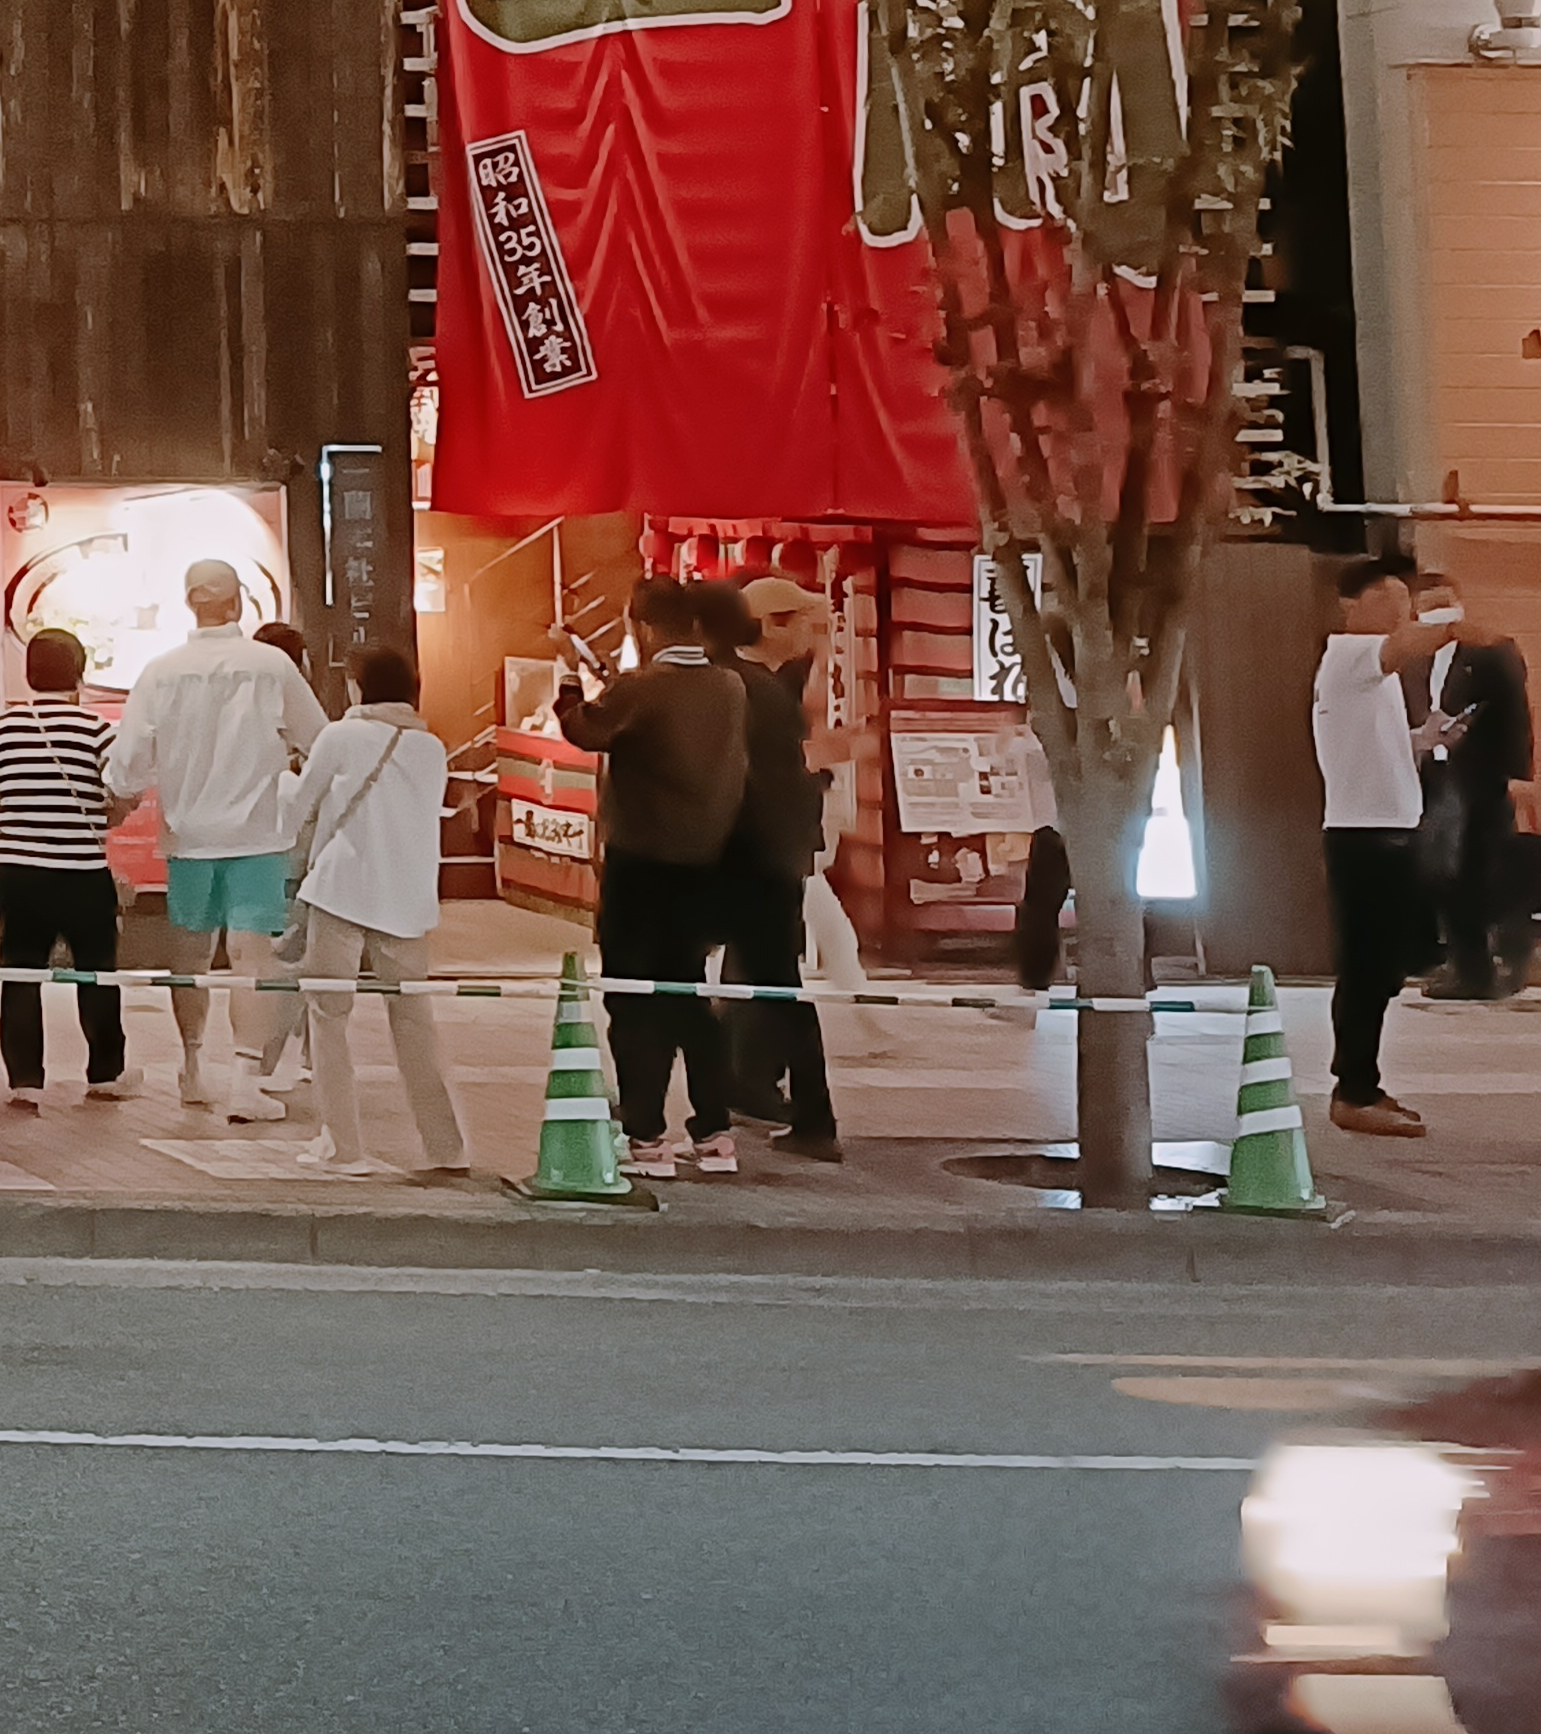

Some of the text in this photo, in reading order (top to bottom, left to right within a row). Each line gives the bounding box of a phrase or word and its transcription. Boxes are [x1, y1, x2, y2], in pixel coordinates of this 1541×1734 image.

[479, 151, 572, 373] 昭和35年創業
